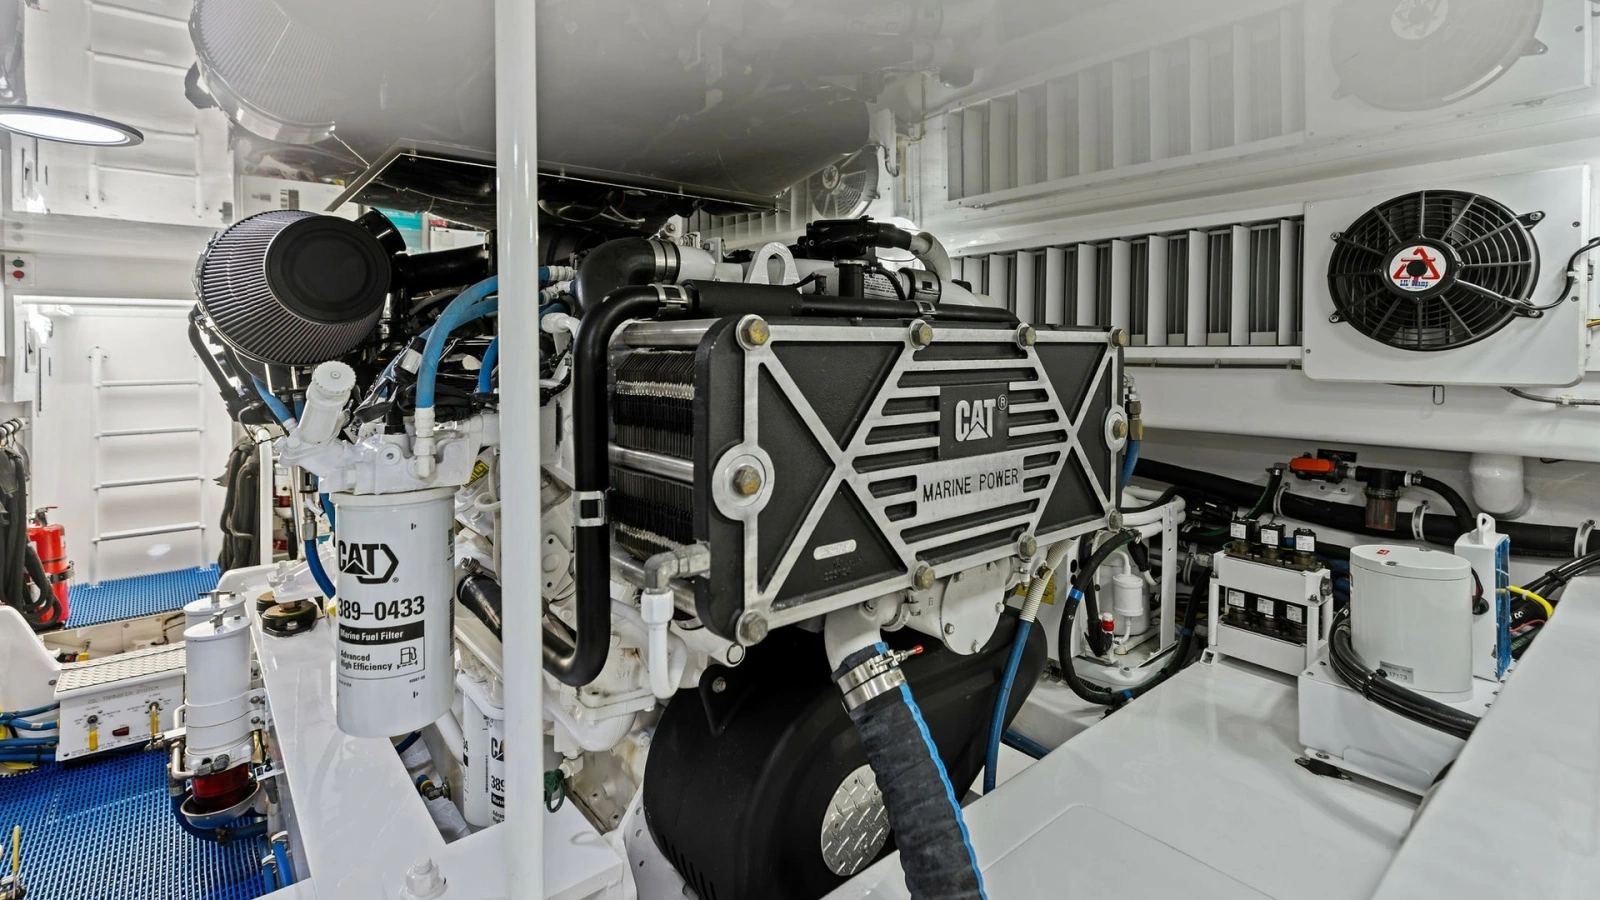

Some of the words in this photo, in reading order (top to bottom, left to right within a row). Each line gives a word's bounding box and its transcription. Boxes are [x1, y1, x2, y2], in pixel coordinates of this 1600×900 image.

[923, 476, 972, 503] MARINE
[979, 468, 1019, 492] POWER
[340, 628, 360, 641] Marine
[361, 632, 379, 641] Fuel
[381, 630, 404, 640] Filter
[340, 649, 371, 662] Advanced
[340, 660, 353, 671] High
[353, 662, 393, 671] Efficiency
